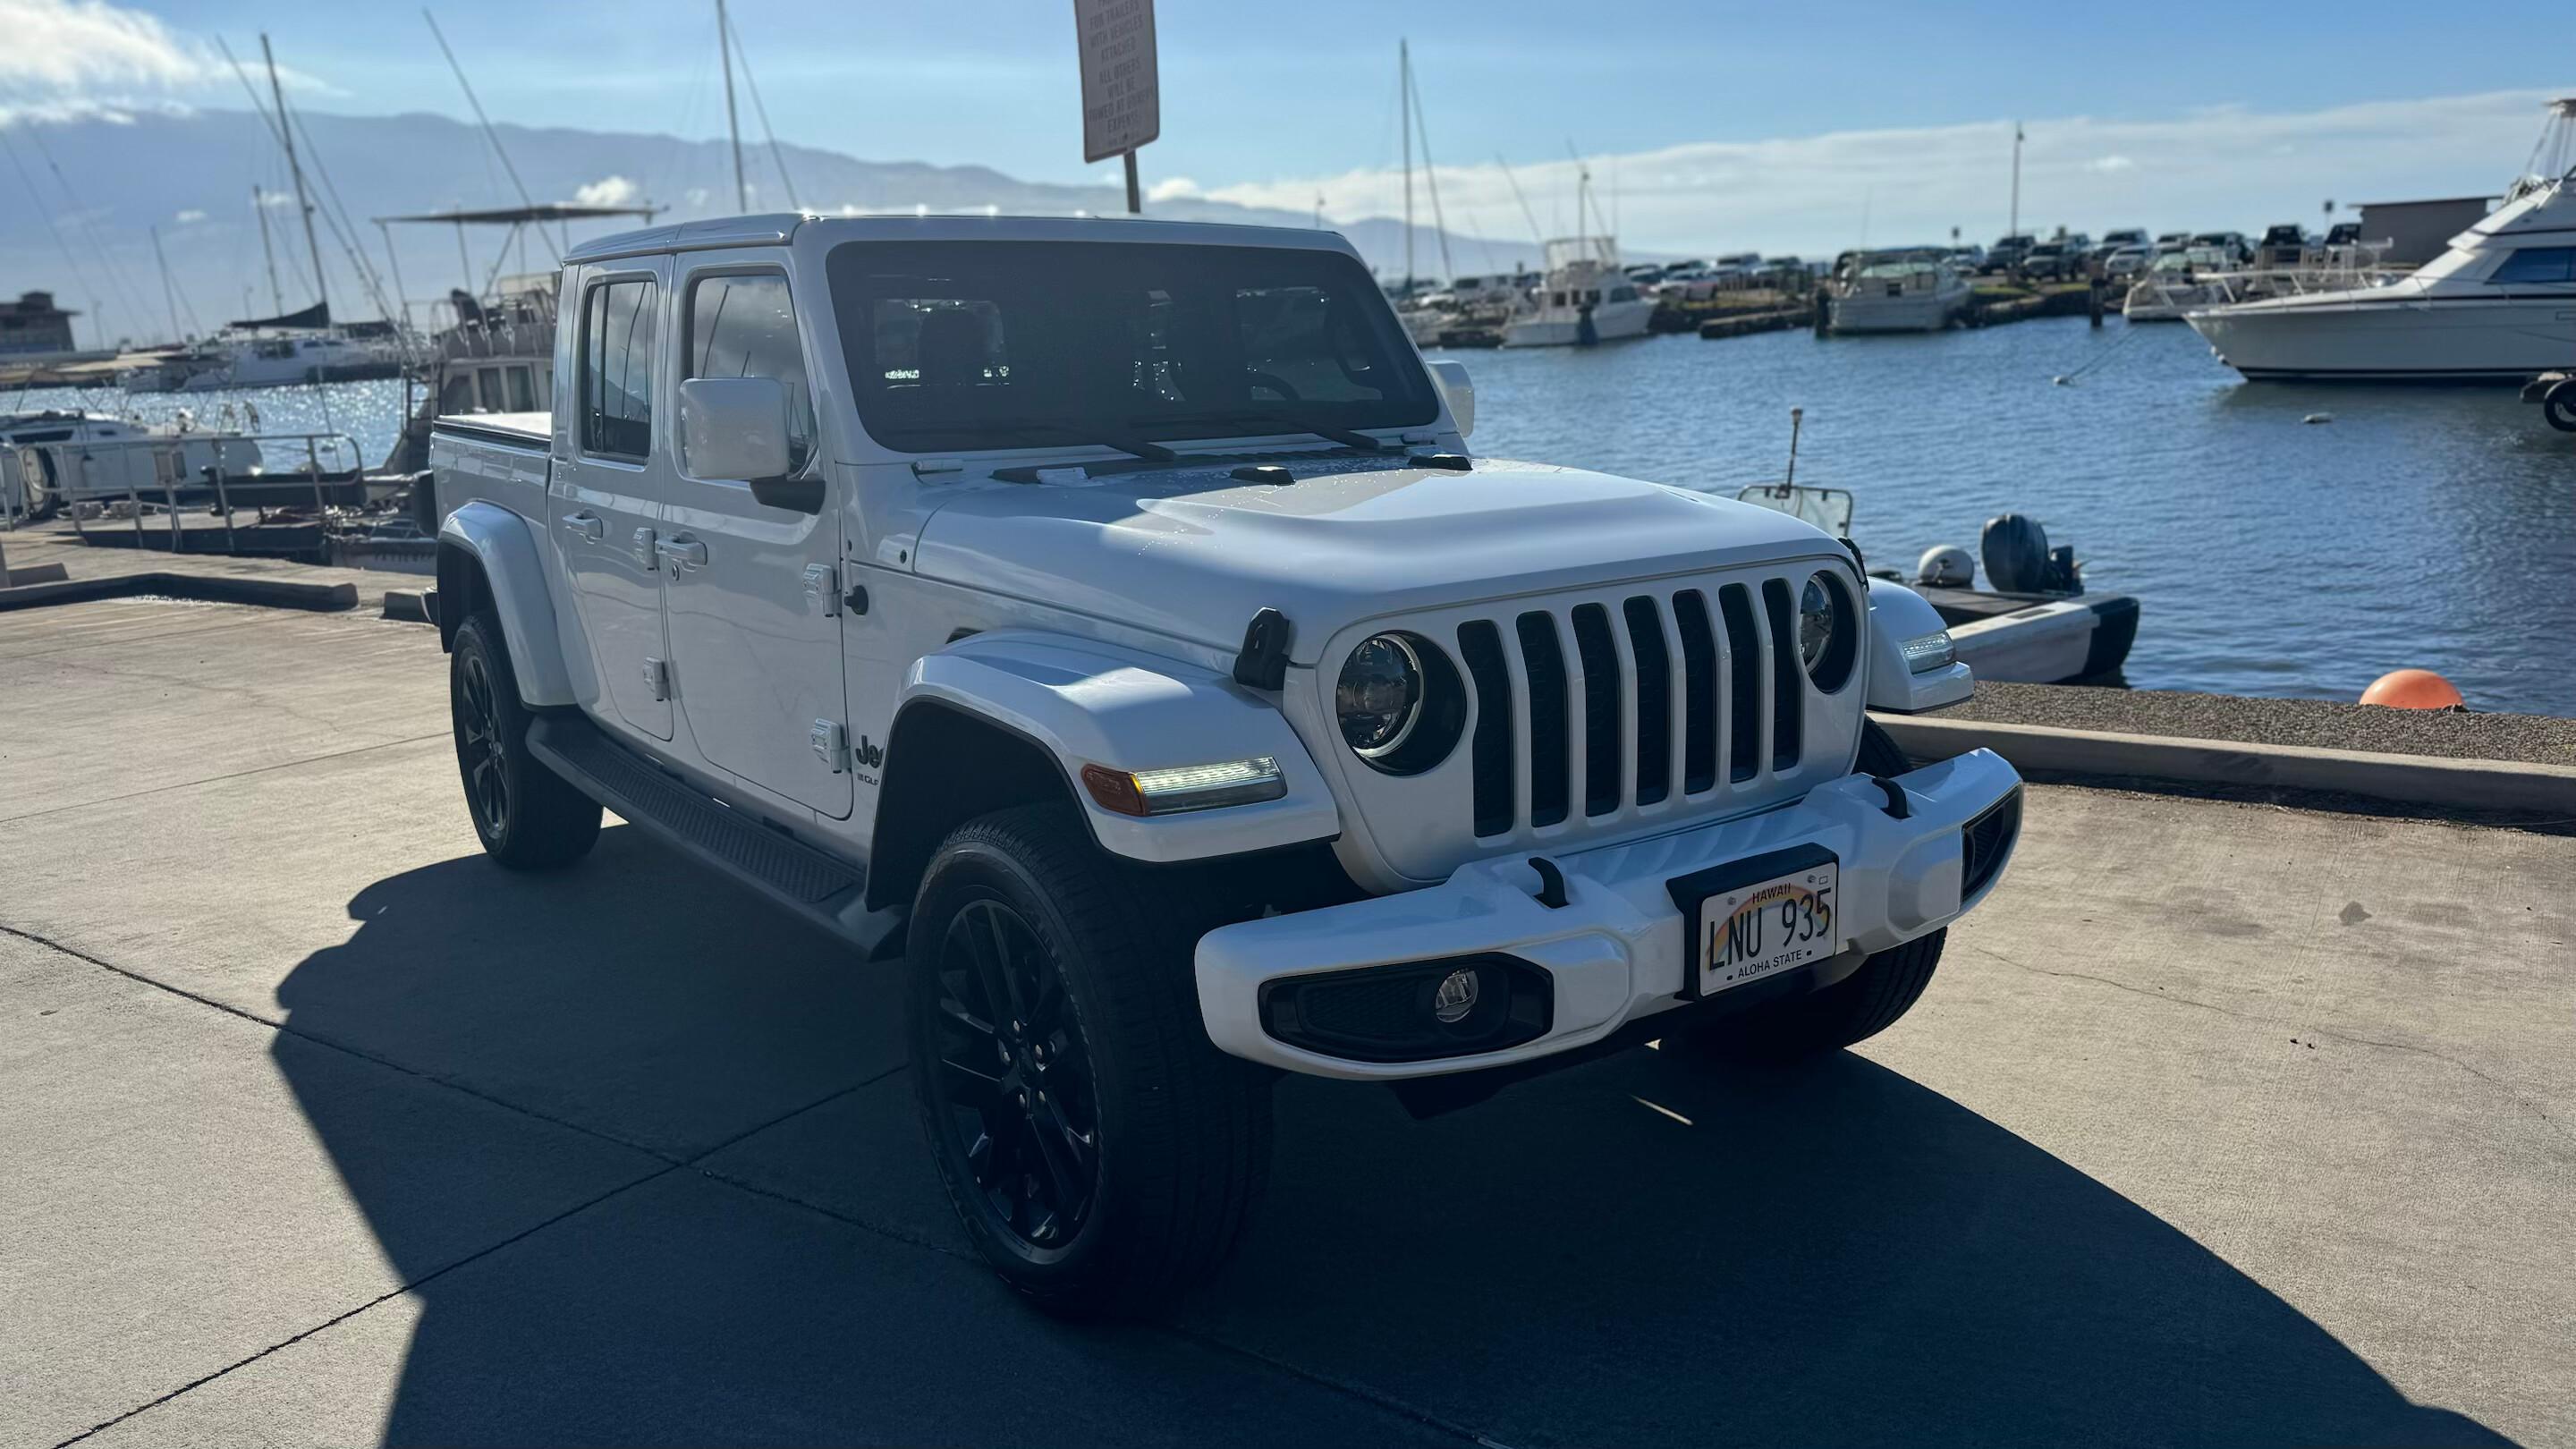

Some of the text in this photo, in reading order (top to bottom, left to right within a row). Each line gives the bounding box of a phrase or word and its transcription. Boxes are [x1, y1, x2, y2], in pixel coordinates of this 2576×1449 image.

[1752, 883, 1792, 904] HAWAII
[1709, 887, 1832, 971] LNU 935
[1738, 949, 1803, 979] ALOHA STATE
